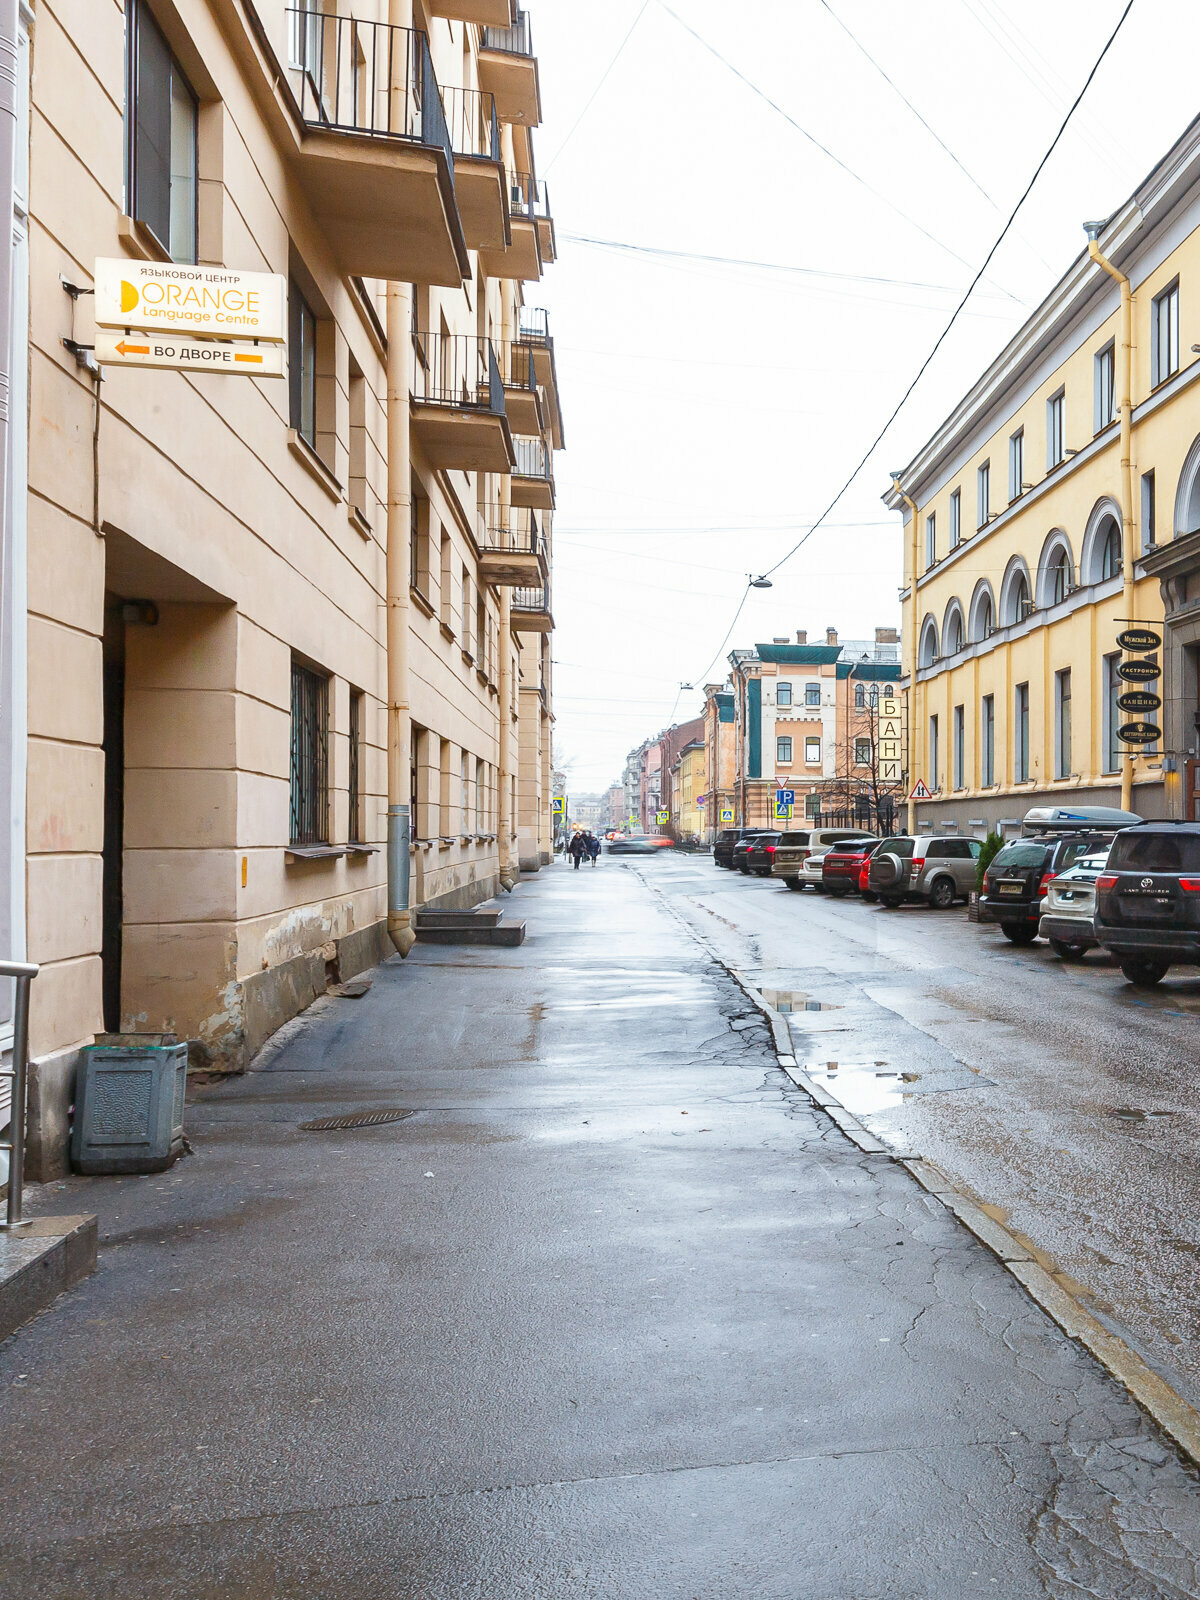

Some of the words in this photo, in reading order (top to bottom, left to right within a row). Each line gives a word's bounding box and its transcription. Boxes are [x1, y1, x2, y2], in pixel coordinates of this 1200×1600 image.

[140, 268, 202, 280] ЯЗЫКОВОЙ
[205, 275, 241, 284] ЦЕНТР
[141, 282, 260, 313] ORANGE
[143, 306, 211, 323] Language
[215, 312, 259, 325] Centre
[154, 346, 176, 358] ВО
[180, 348, 232, 362] ДВОРЕ
[884, 700, 897, 778] БАНИ
[783, 791, 793, 804] P
